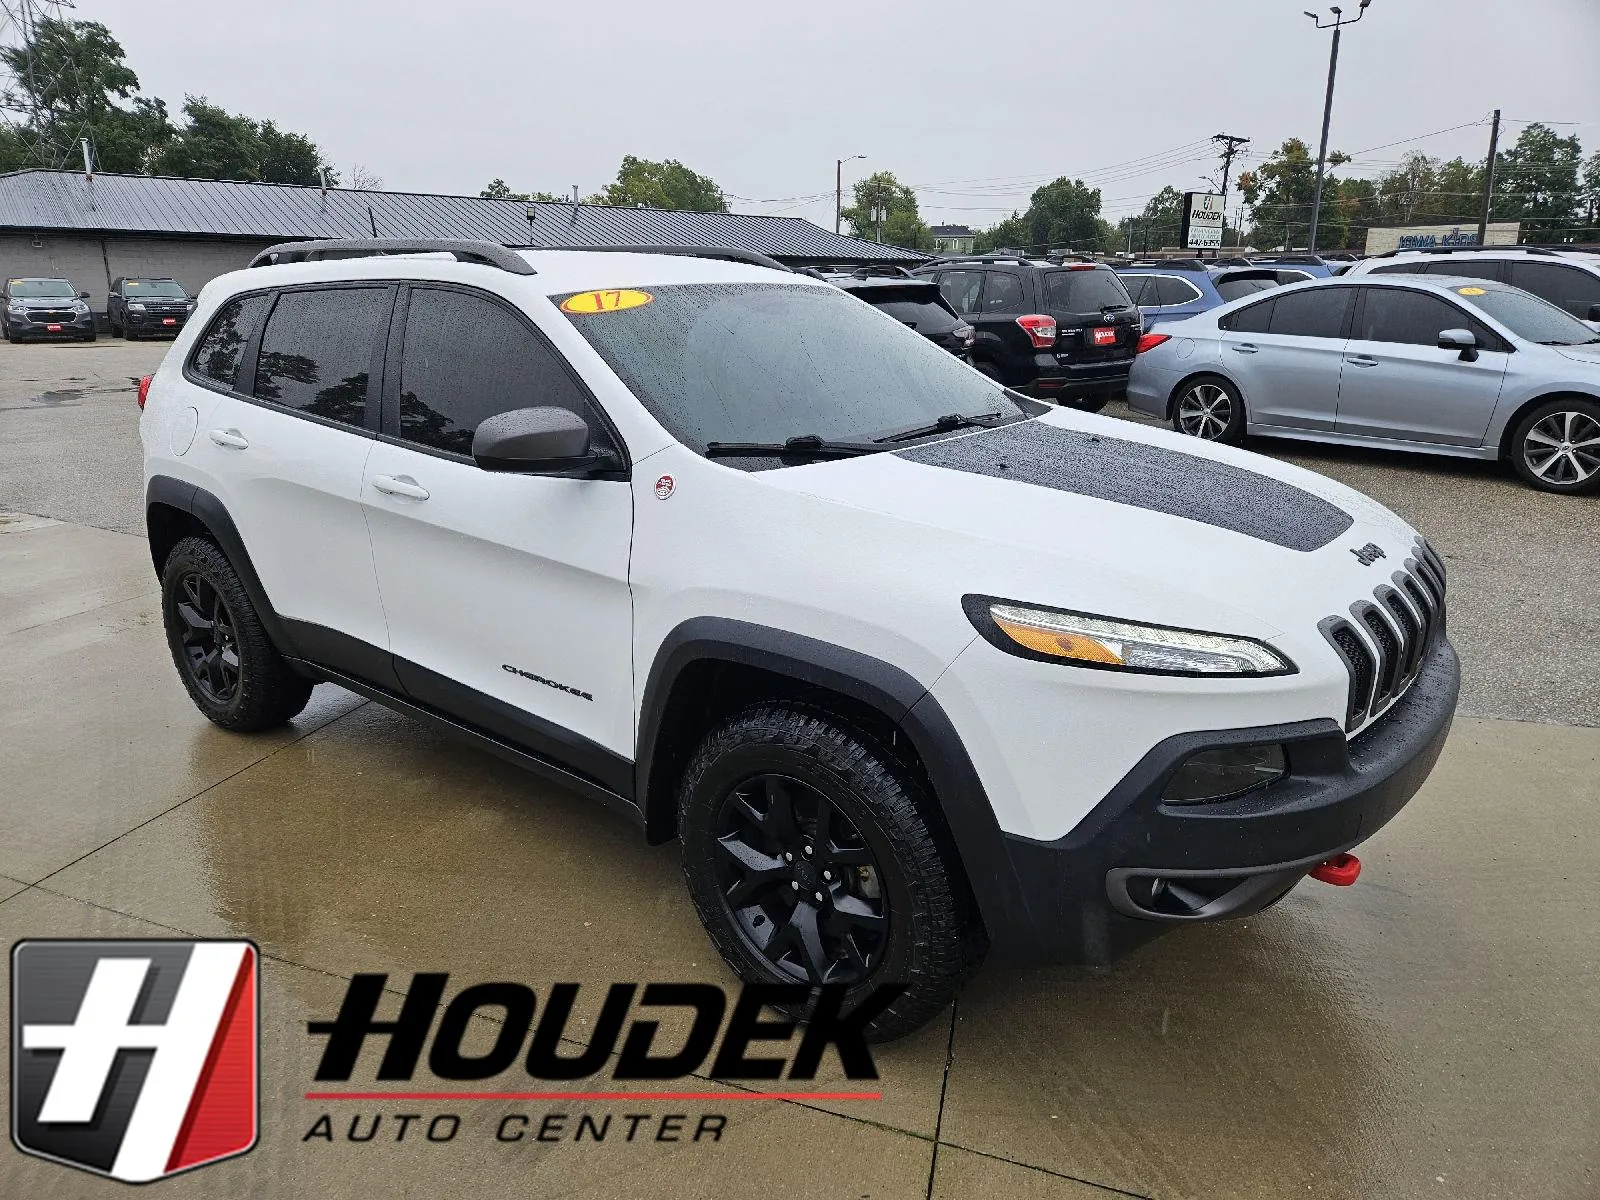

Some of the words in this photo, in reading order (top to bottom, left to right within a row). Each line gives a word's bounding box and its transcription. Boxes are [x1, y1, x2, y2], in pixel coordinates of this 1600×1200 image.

[1192, 210, 1222, 220] HOUDEK
[593, 291, 621, 311] 17
[501, 664, 594, 701] CHEROKEE
